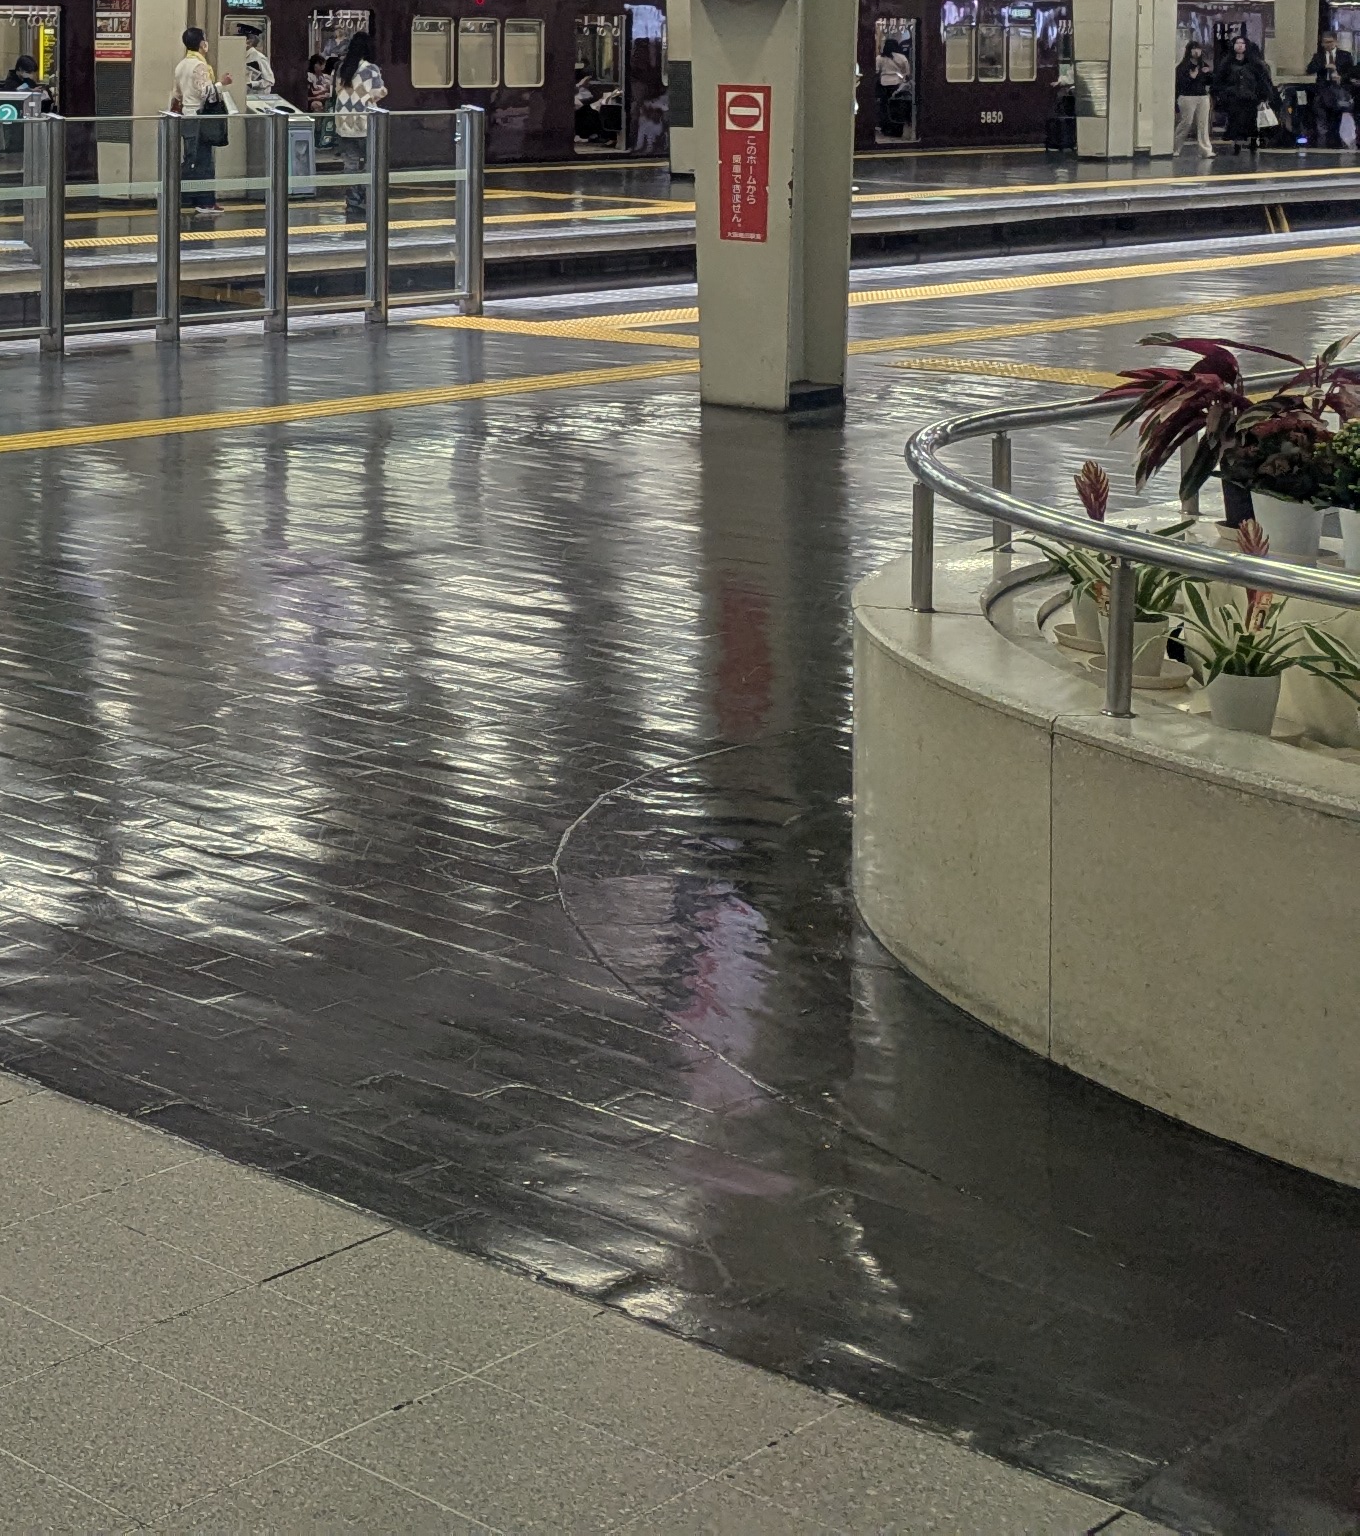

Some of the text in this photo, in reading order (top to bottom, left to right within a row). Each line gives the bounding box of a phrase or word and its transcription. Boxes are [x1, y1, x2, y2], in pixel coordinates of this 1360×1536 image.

[1, 107, 12, 121] 2
[980, 110, 1004, 124] 5850
[746, 135, 757, 205] このホームから
